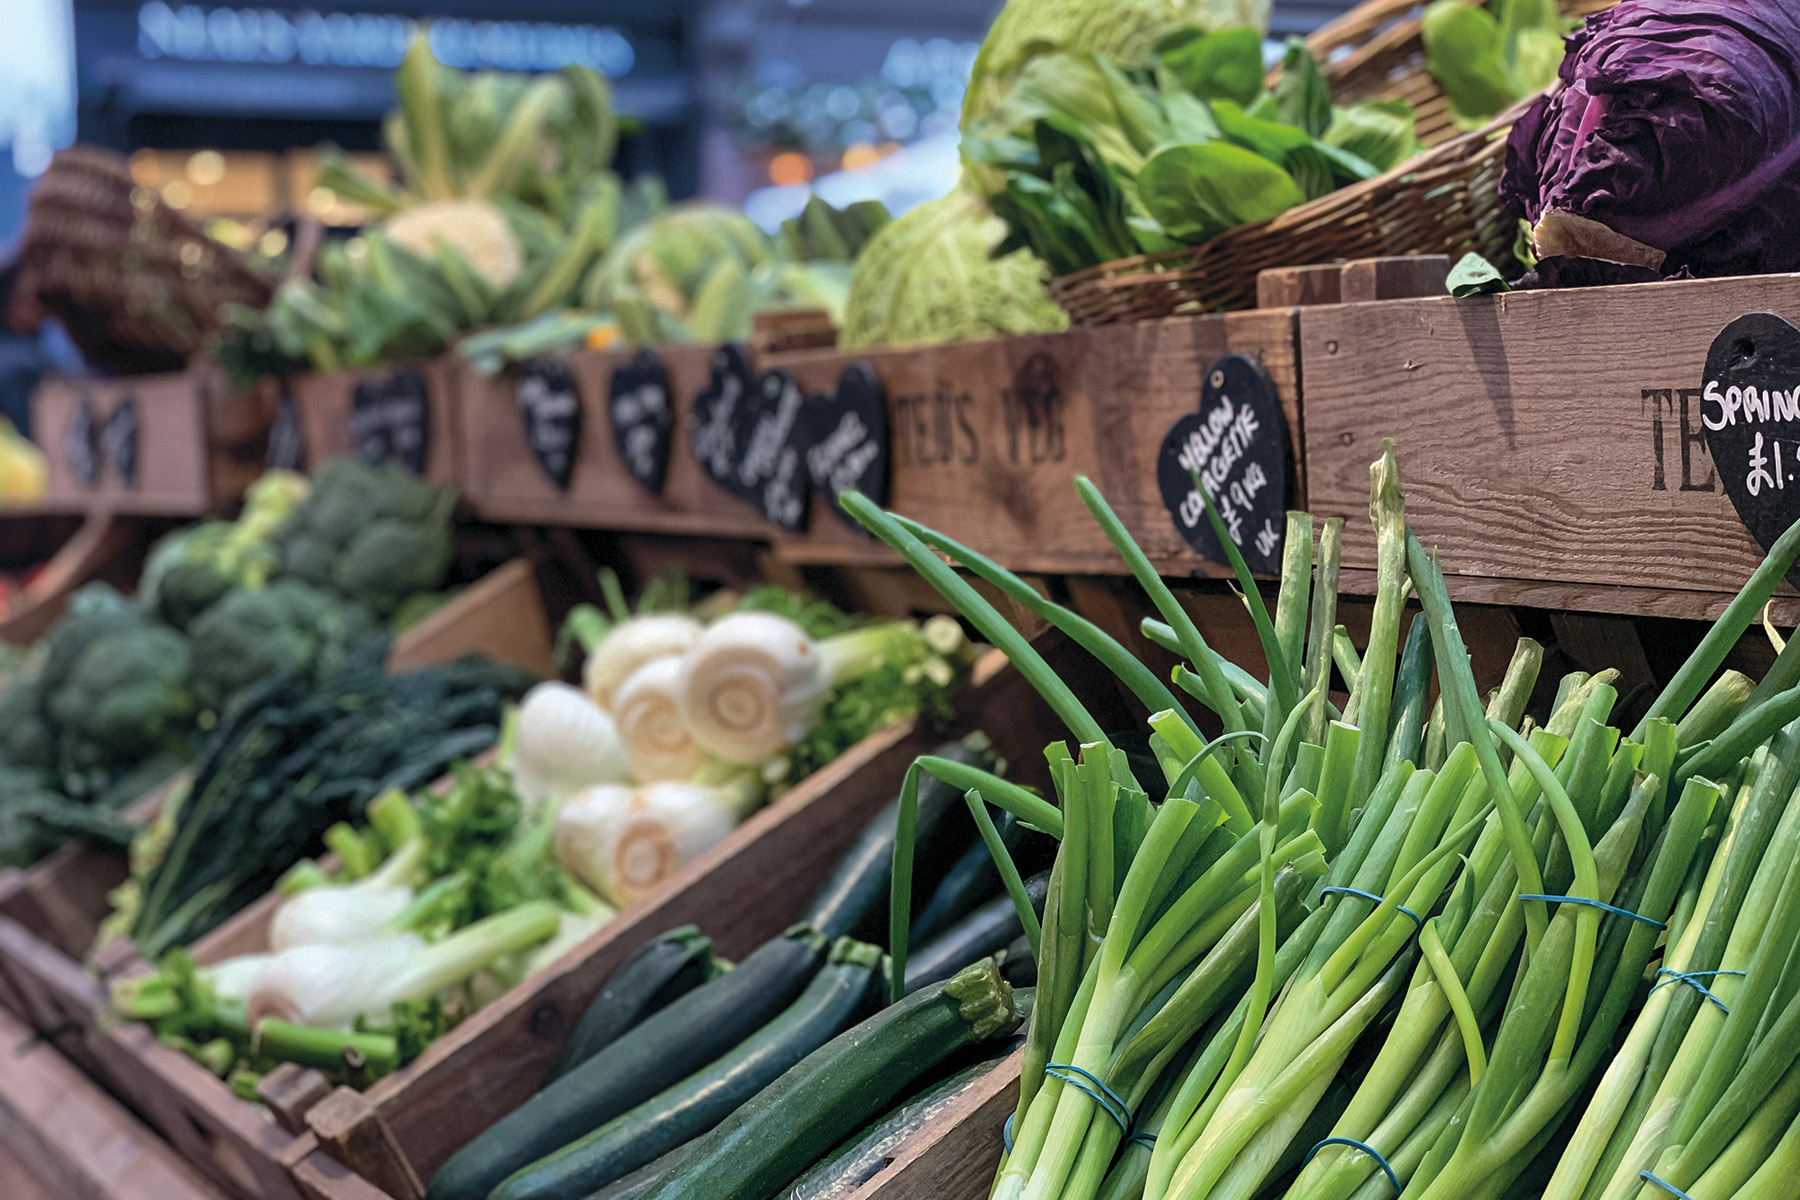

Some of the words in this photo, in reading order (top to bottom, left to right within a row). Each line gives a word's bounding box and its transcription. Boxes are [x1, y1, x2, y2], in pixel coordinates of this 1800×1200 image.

[1178, 395, 1234, 472] YELLOW
[1641, 388, 1727, 495] TE
[1746, 431, 1800, 497] £1.
[1255, 518, 1280, 557] UK
